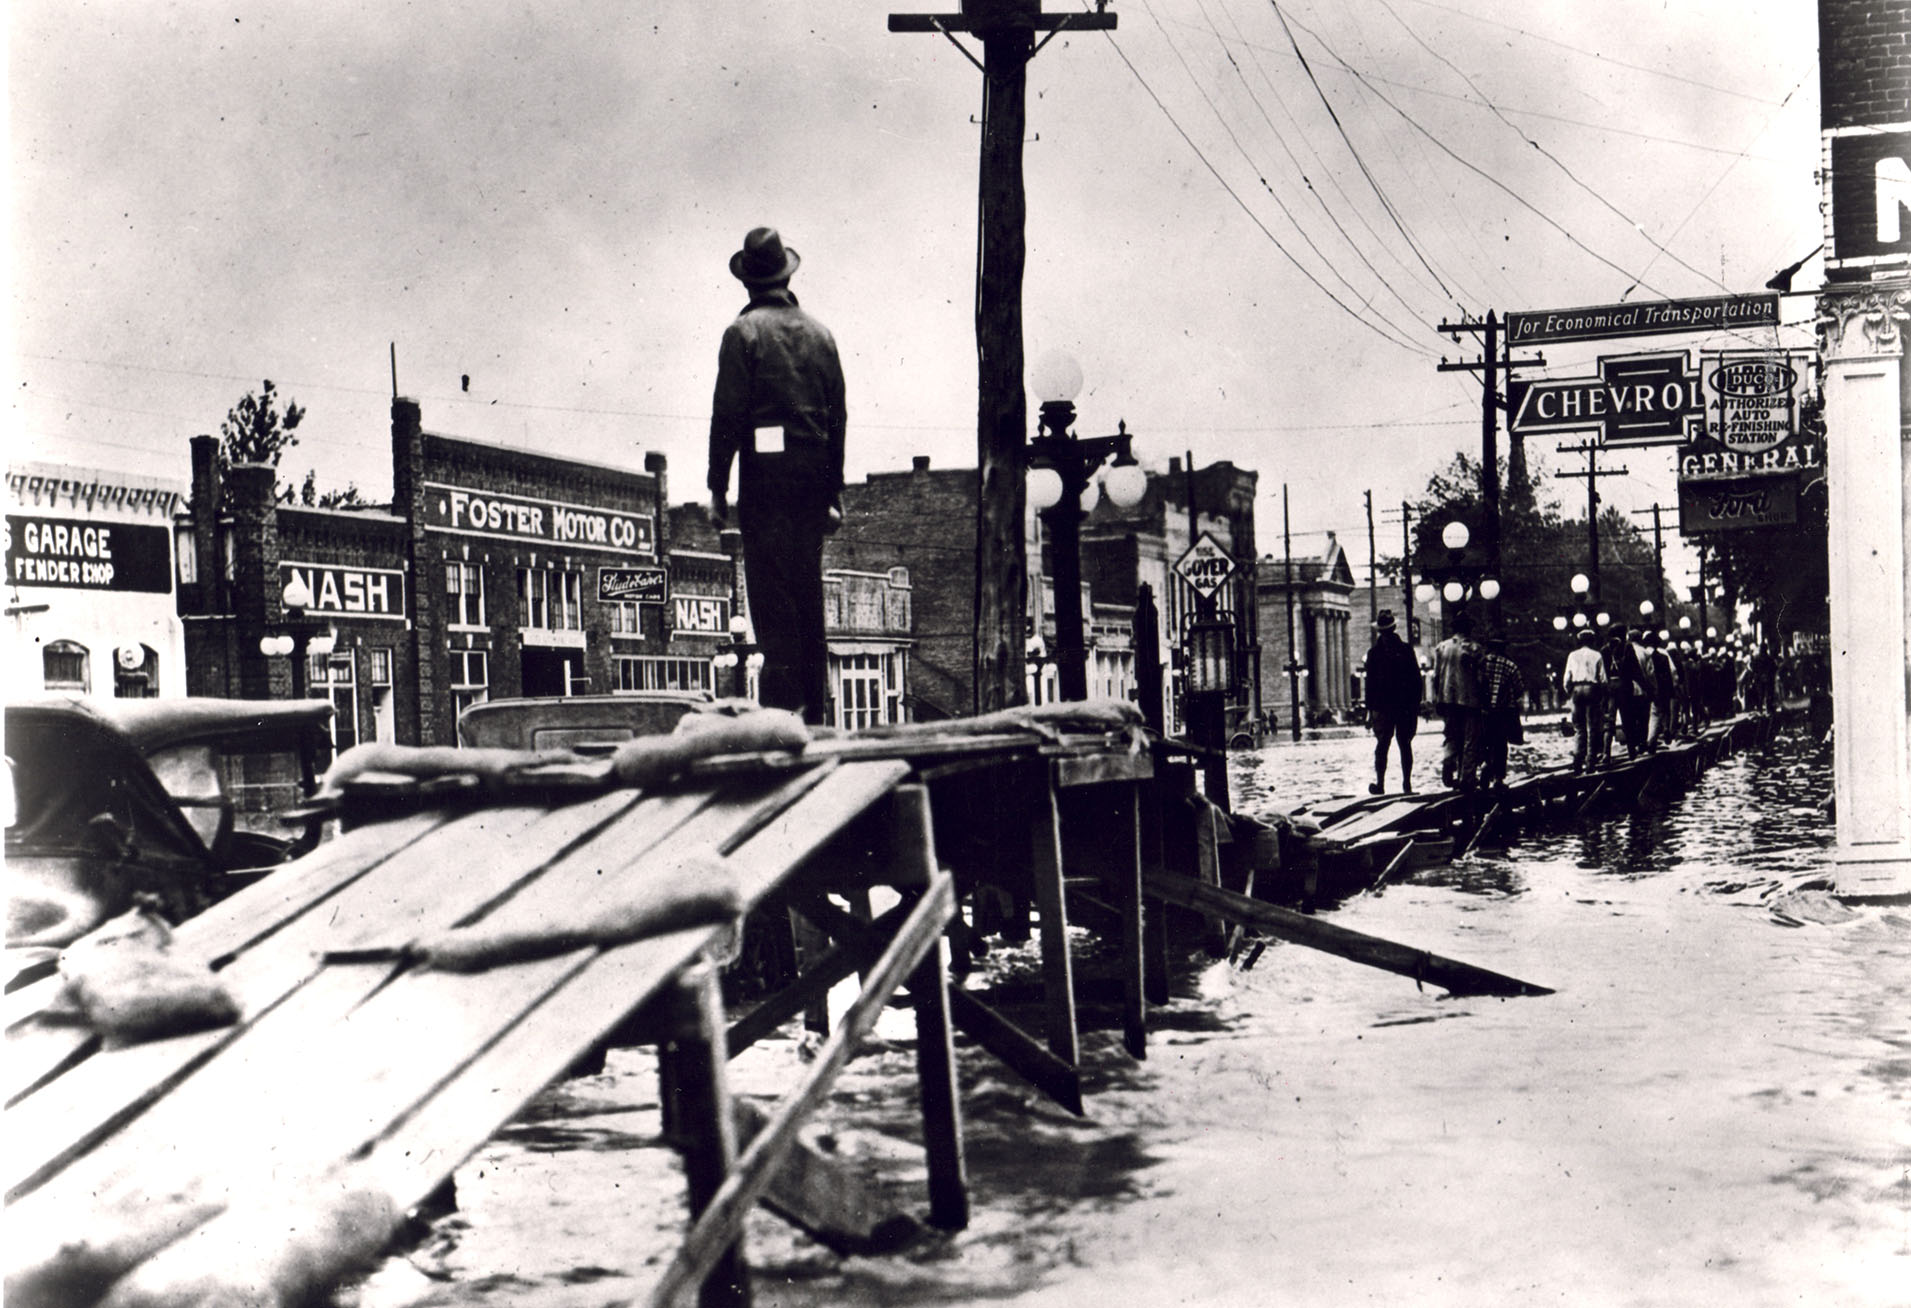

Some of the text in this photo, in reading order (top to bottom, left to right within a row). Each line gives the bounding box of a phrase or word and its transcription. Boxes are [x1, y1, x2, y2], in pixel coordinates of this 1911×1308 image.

[1514, 301, 1773, 339] for Economical Transportation
[1731, 410, 1771, 421] AUTO
[1728, 432, 1778, 444] STATION
[1682, 444, 1820, 475] GENERAL
[450, 491, 544, 535] FOSTER
[552, 506, 607, 543] MOTOR
[1708, 488, 1773, 520] Ford
[24, 522, 112, 559] GARAGE
[15, 557, 115, 585] FENDER SHOP
[1195, 578, 1217, 588] GAS
[290, 568, 389, 612] NASH
[675, 599, 722, 631] NASH
